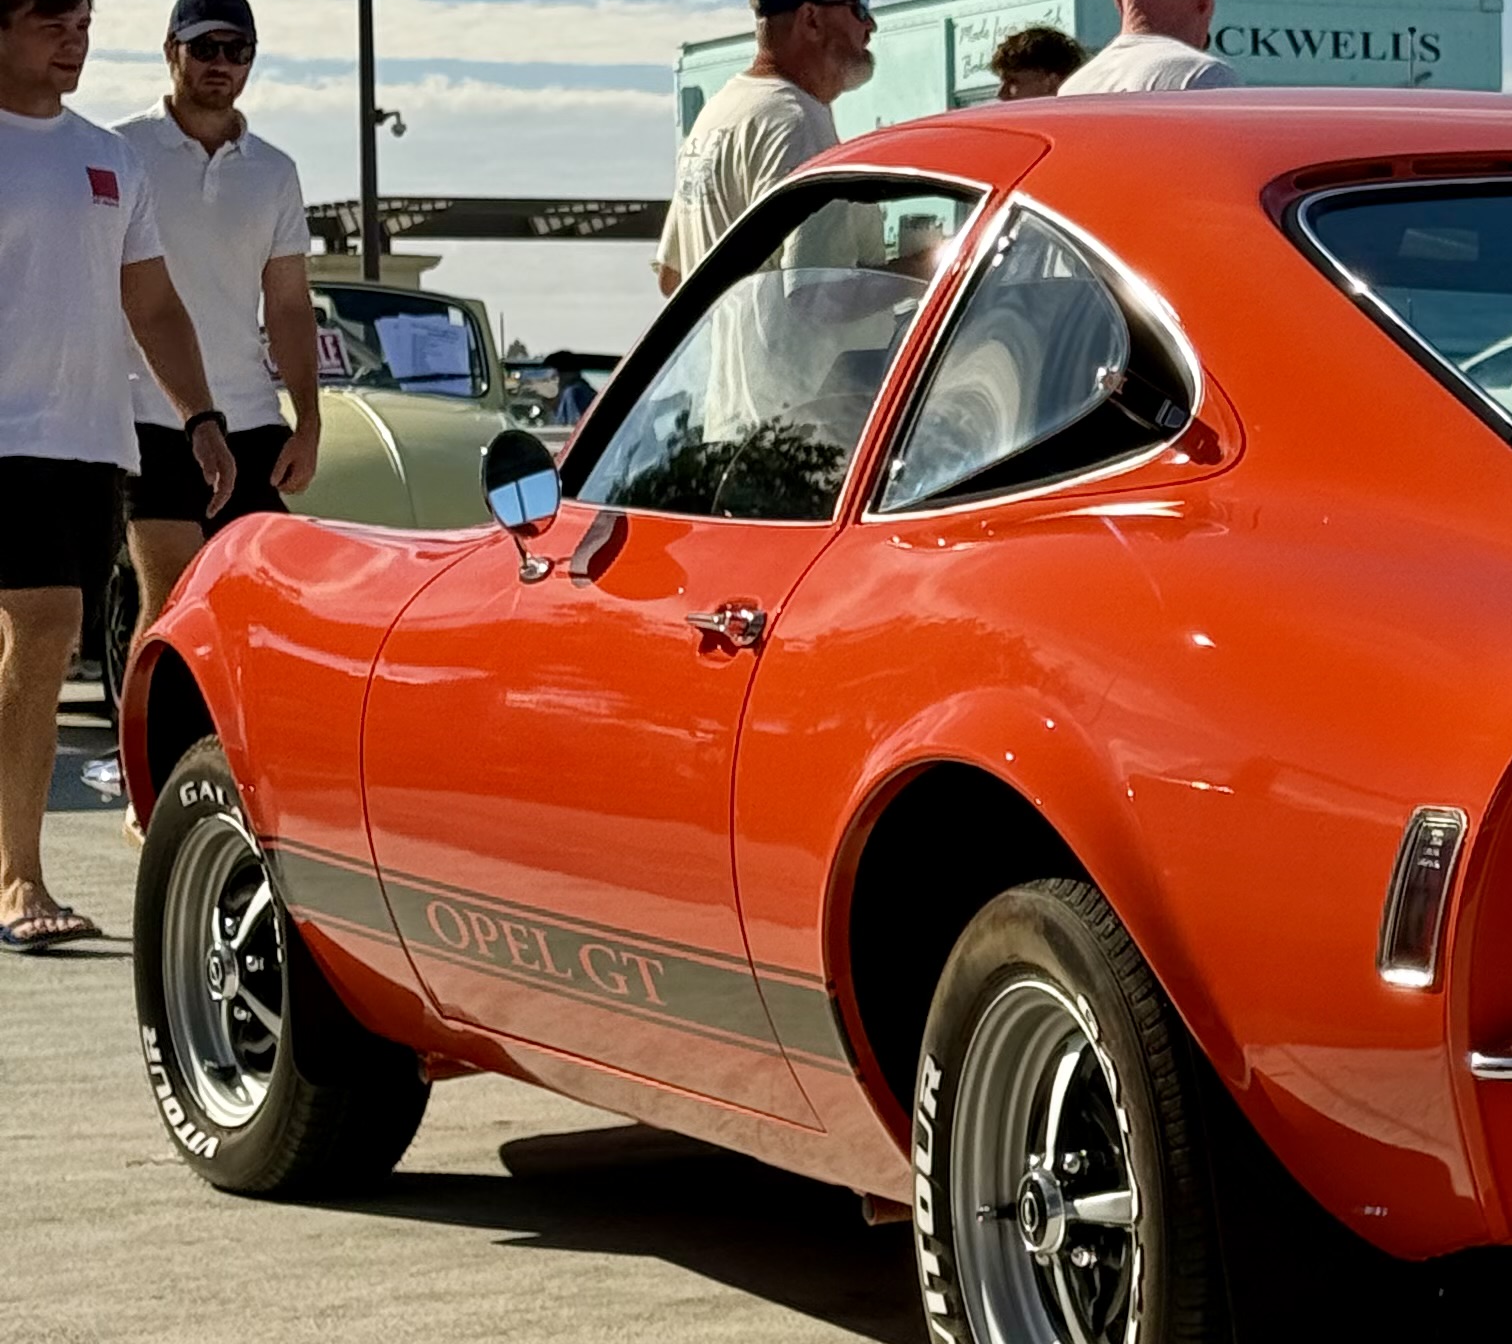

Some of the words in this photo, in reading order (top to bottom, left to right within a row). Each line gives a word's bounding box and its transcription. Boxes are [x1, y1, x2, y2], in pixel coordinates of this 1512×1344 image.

[1204, 24, 1441, 63] CKWELL'S
[426, 900, 574, 981] OPEL
[578, 943, 669, 1006] GT
[142, 1024, 219, 1158] VITOUR
